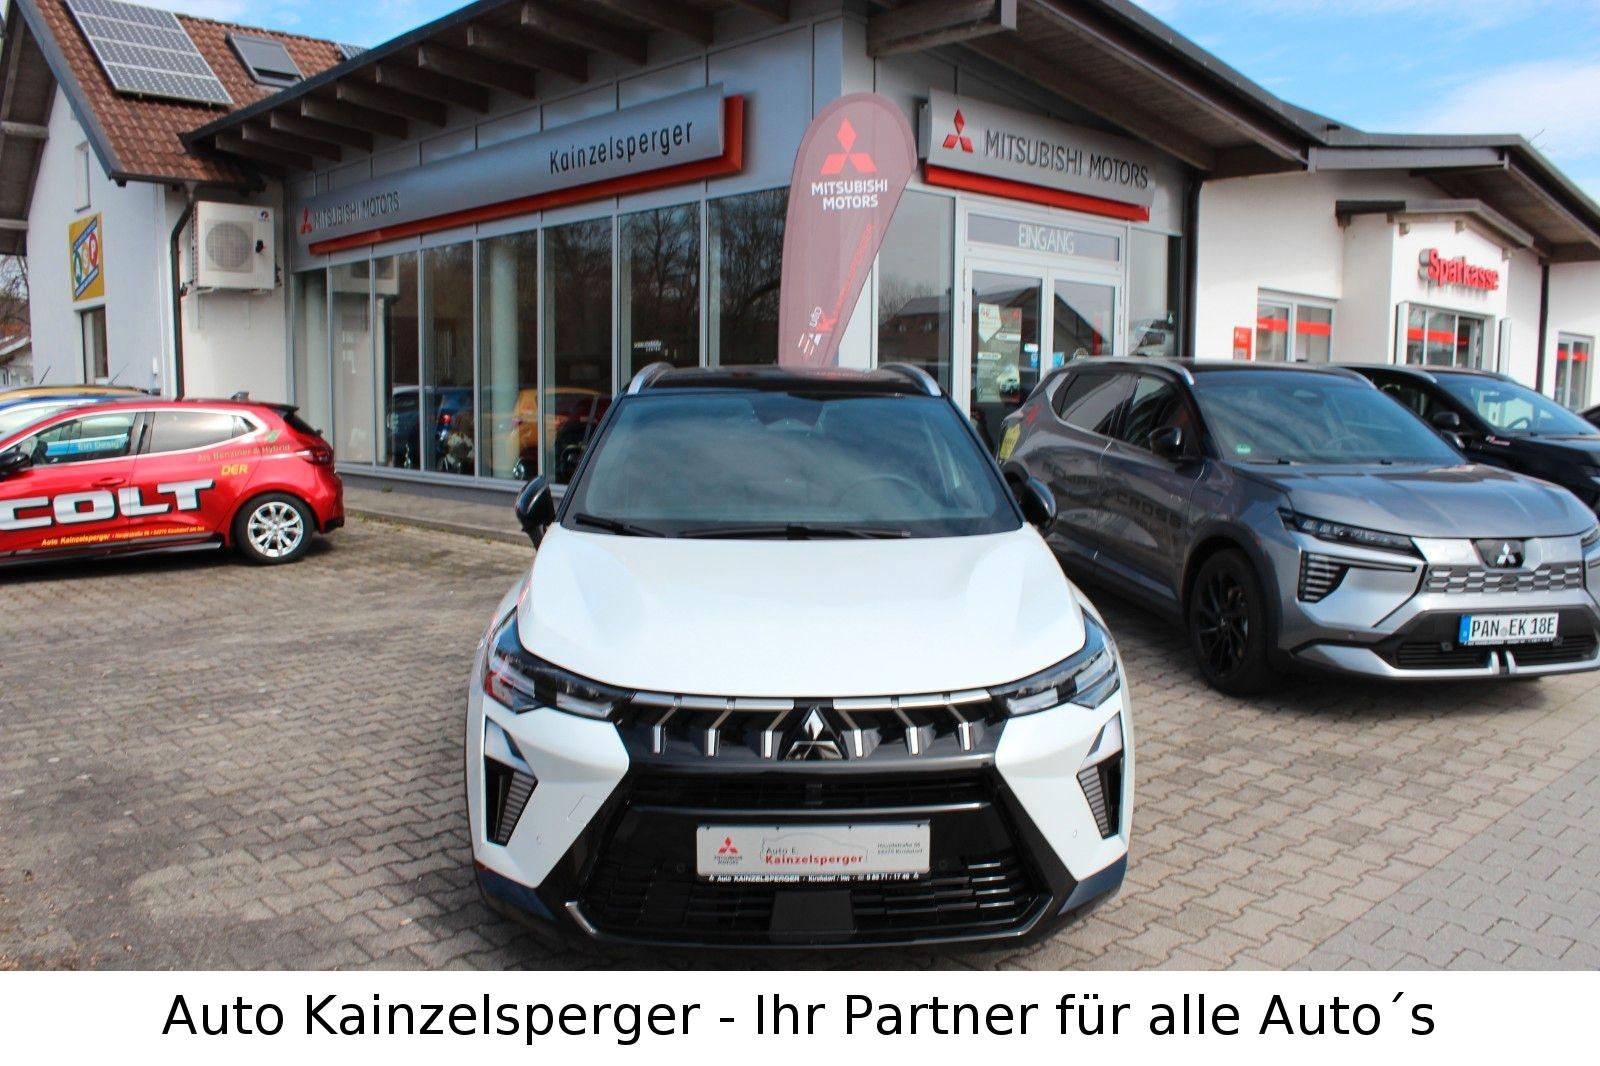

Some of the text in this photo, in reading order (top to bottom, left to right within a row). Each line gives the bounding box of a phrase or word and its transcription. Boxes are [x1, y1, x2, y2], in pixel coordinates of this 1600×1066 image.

[550, 121, 692, 174] Kainzelsperger
[985, 128, 1148, 189] MITSUBISHI MOTORS
[811, 179, 888, 196] MITSUBISHI
[314, 190, 400, 231] MITSUBISHI MOTORS
[822, 193, 879, 210] MOTORS
[1018, 223, 1075, 254] EINGANG
[1424, 248, 1499, 291] Sparkasse
[221, 463, 249, 477] DER
[0, 478, 215, 531] COLT
[41, 538, 59, 547] Auto
[1471, 616, 1556, 638] PAN EK 18E
[765, 854, 864, 866] Kainzelsperger
[766, 847, 788, 855] Auto
